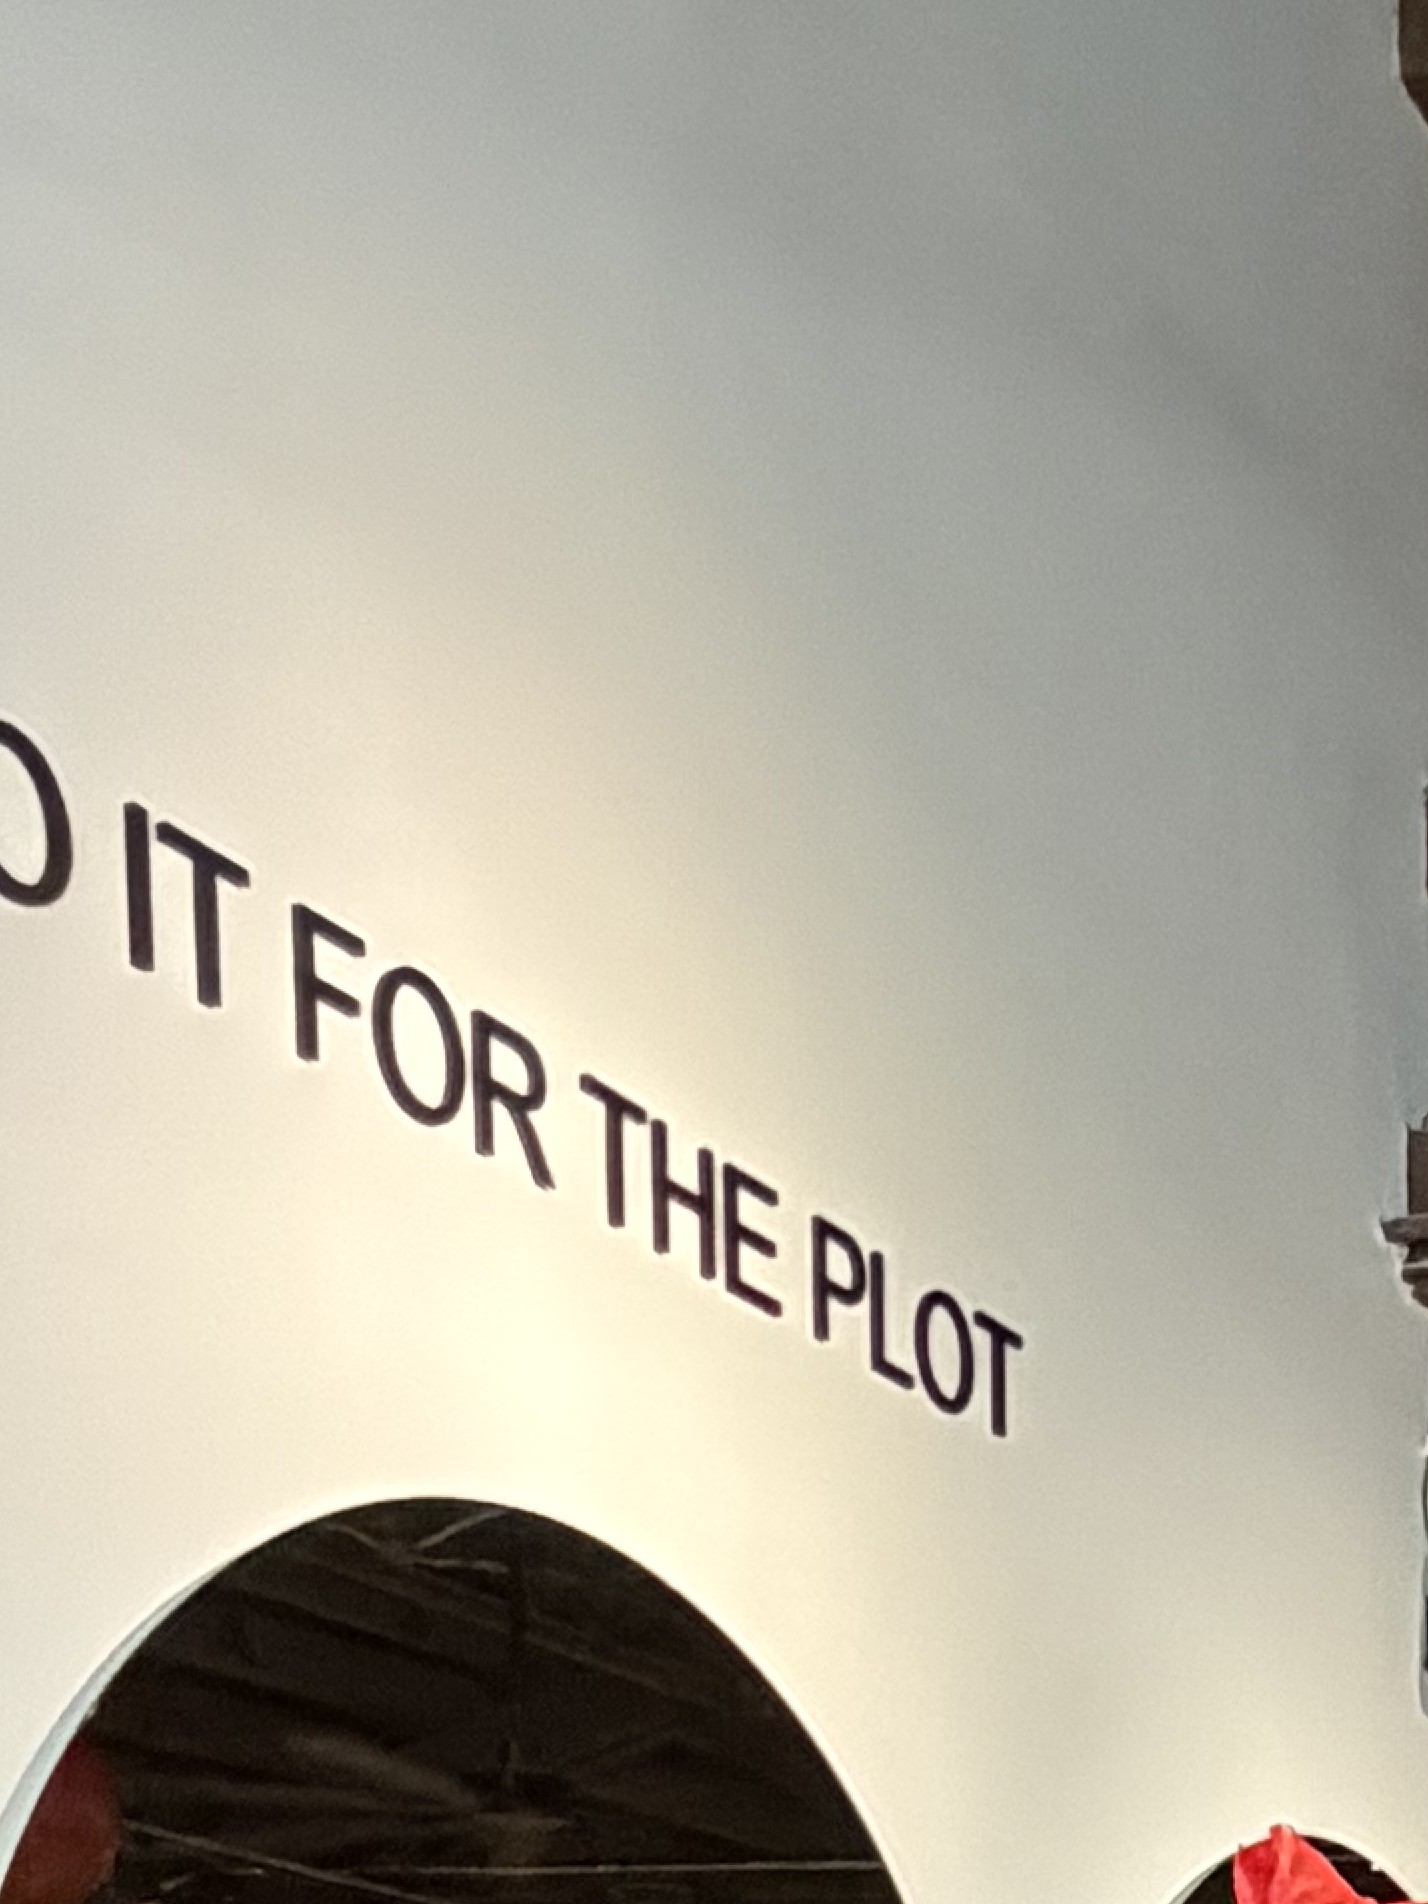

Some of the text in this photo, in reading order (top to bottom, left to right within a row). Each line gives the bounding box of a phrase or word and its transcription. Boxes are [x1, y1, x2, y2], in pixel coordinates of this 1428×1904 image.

[124, 802, 250, 1006] IT
[292, 904, 553, 1188] FOR
[580, 1074, 782, 1317] THE
[812, 1216, 1024, 1438] PLOT
